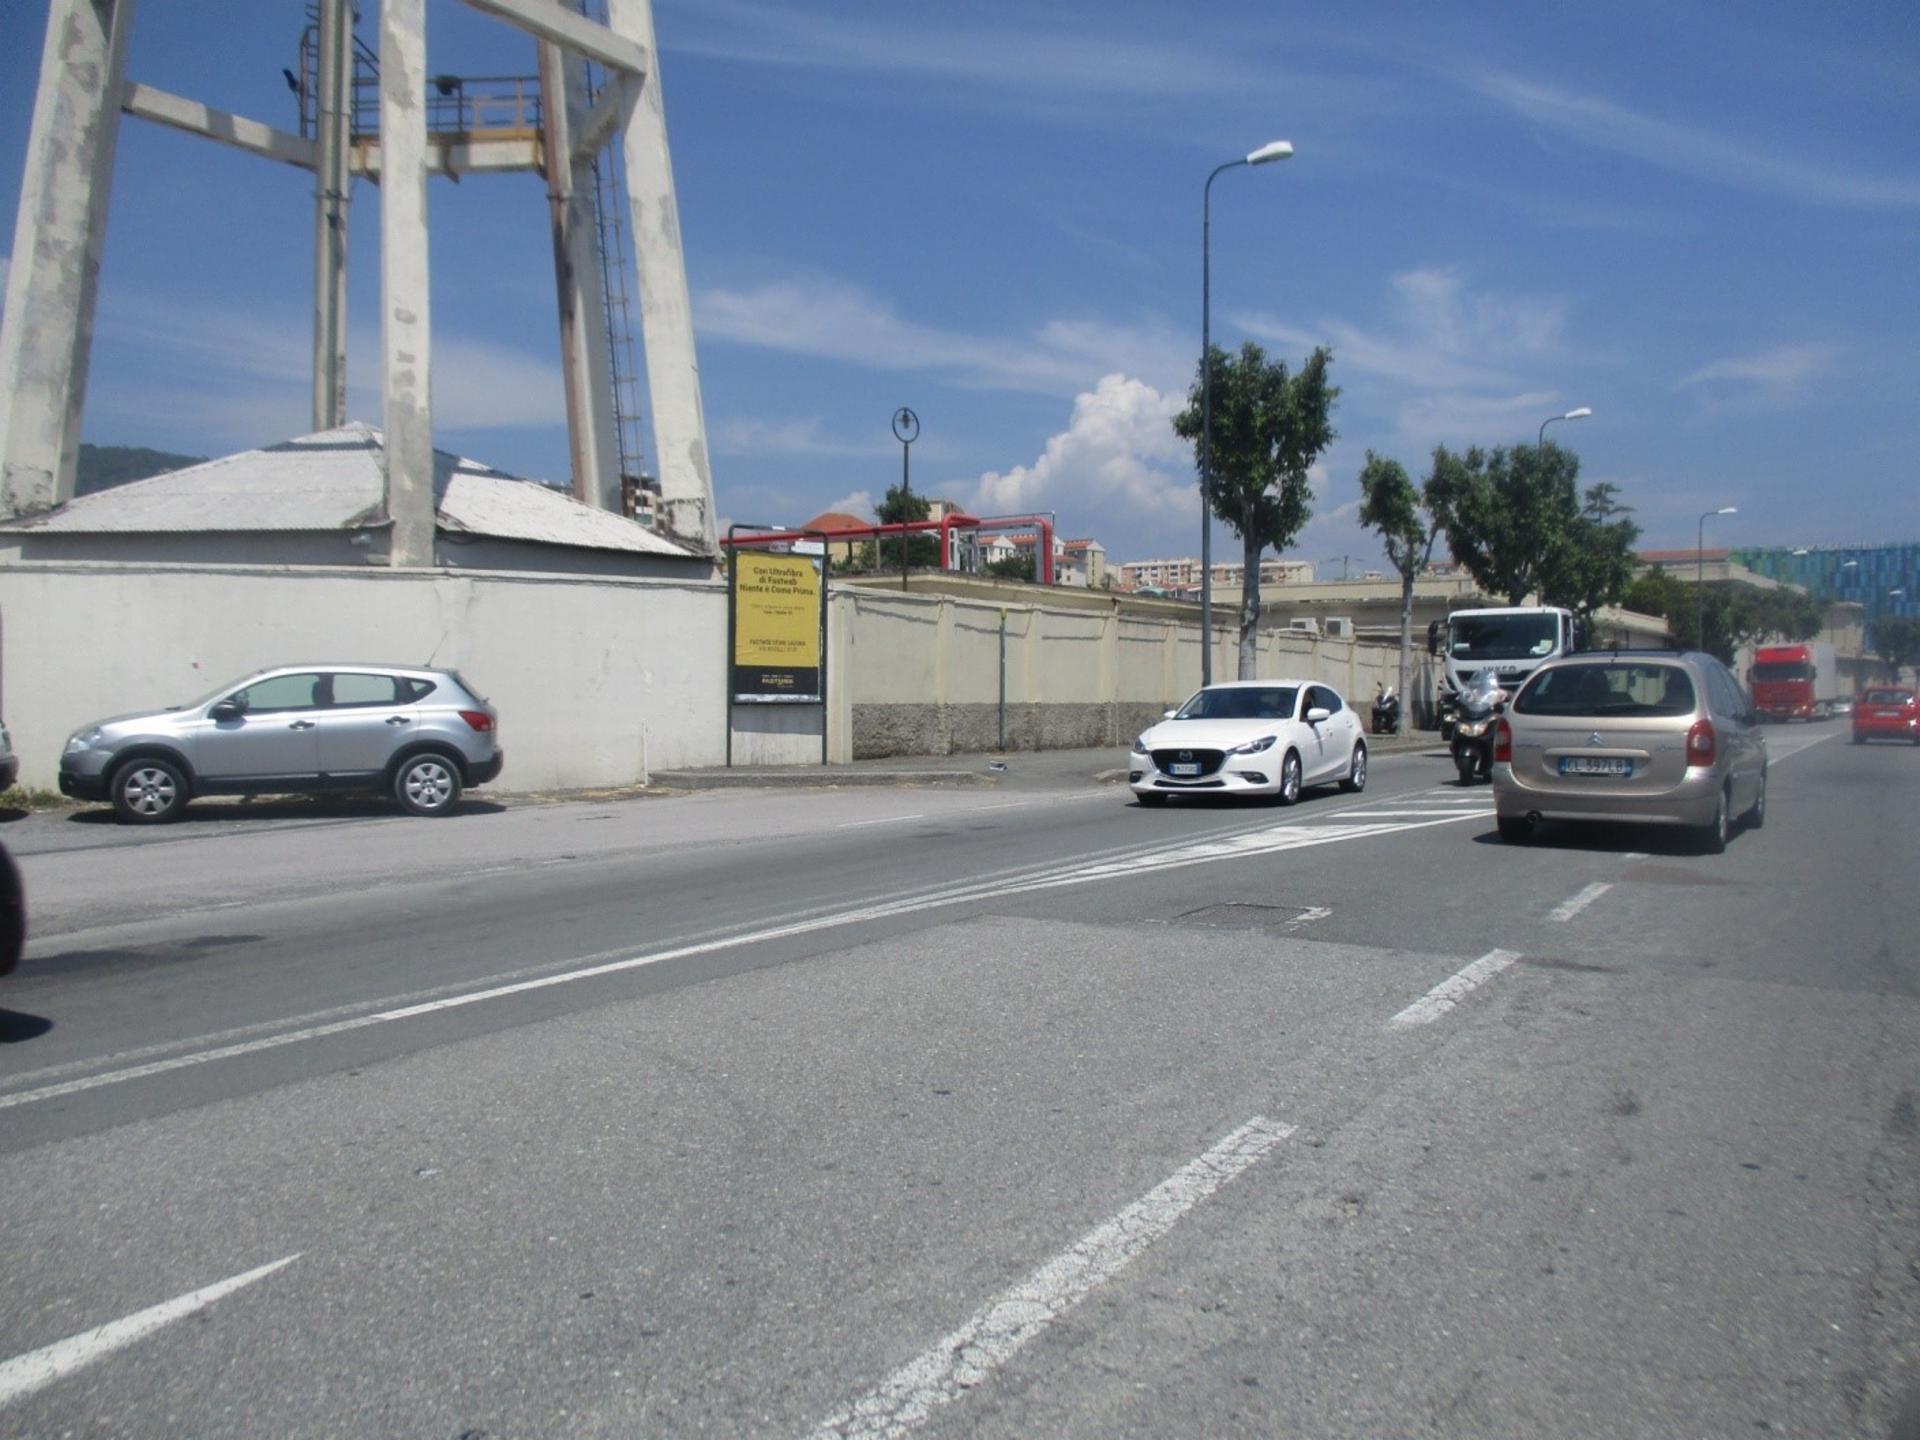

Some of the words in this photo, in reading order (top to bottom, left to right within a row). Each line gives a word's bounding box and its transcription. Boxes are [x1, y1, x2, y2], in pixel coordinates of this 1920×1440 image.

[753, 566, 768, 574] Con
[769, 567, 803, 577] Ultrafibra
[759, 575, 766, 584] di
[768, 576, 797, 586] Fastweb
[740, 583, 763, 592] Niente
[771, 586, 791, 594] Come
